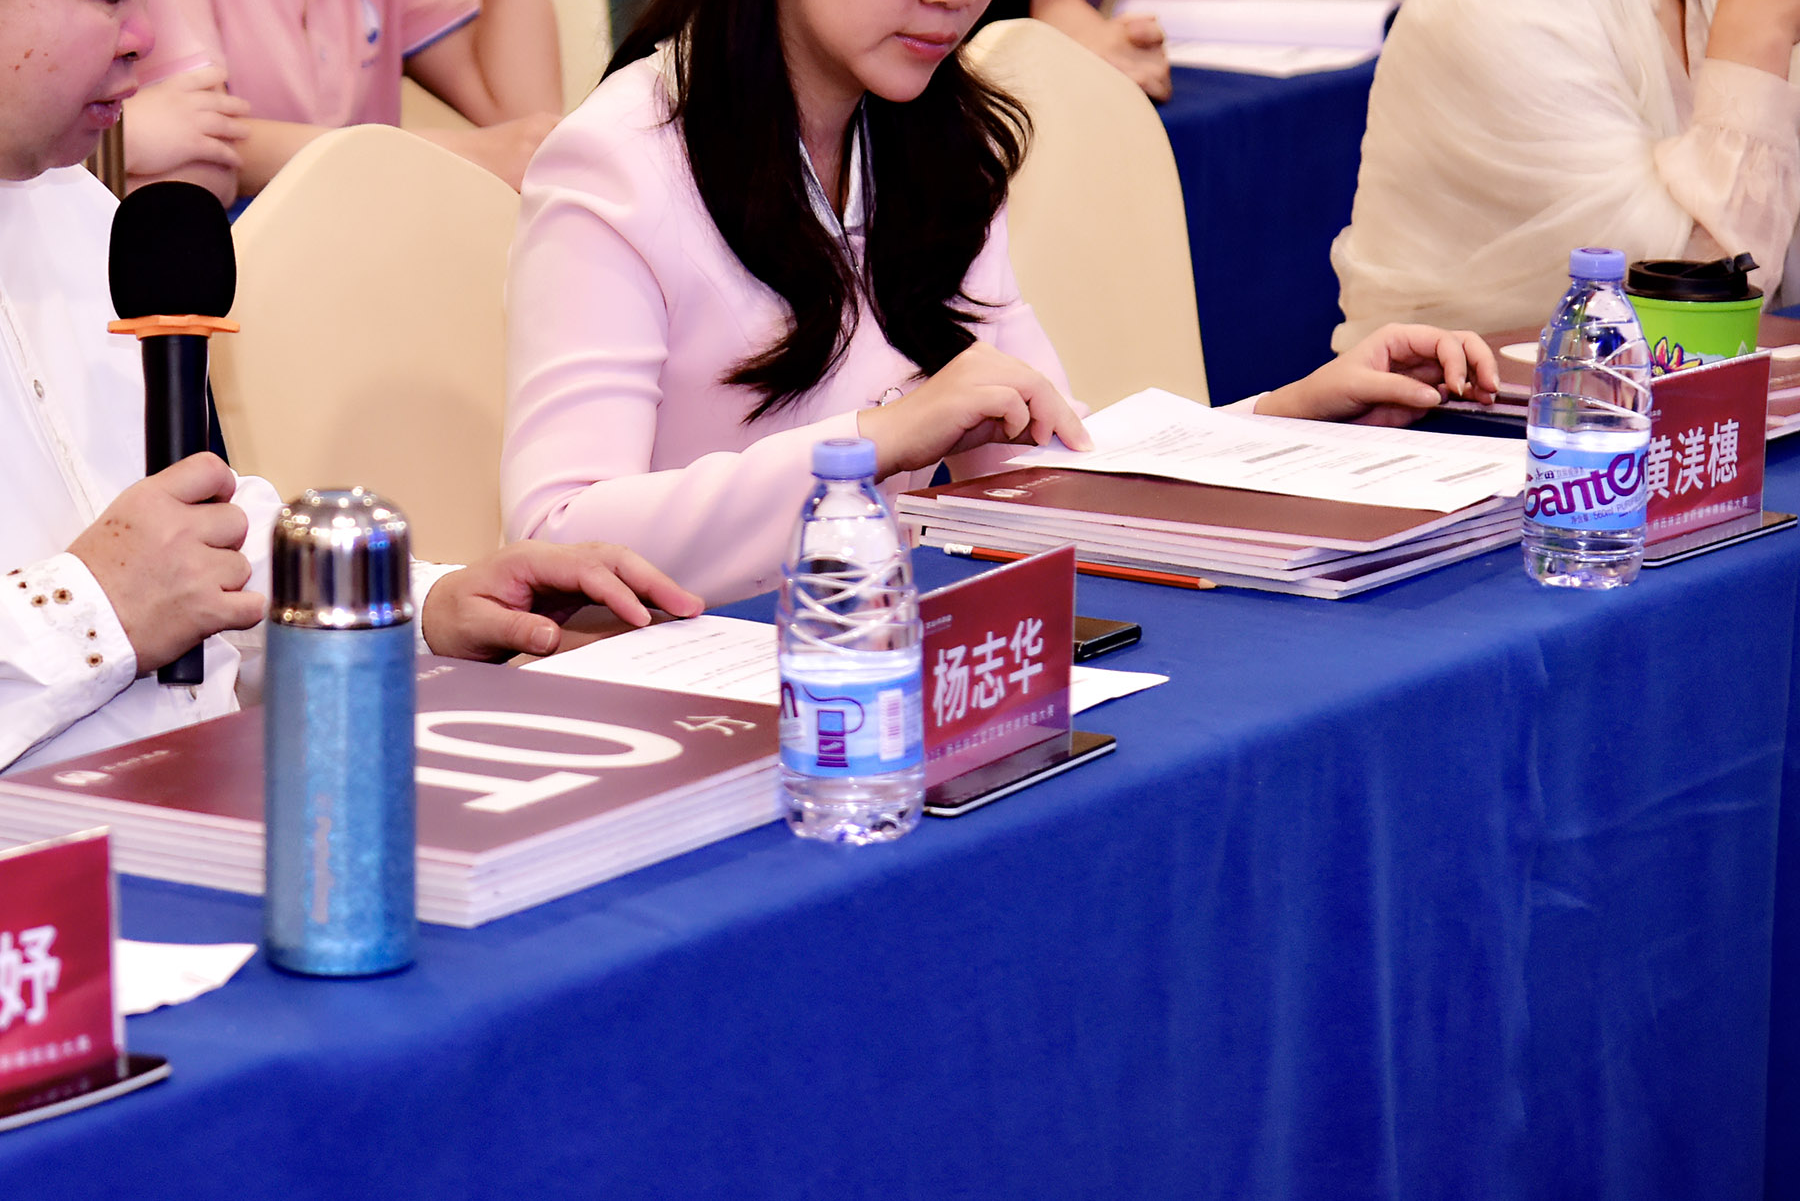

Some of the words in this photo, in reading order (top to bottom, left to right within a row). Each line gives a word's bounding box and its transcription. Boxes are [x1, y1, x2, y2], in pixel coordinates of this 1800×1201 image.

[932, 616, 1044, 729] 杨志华
[414, 709, 683, 815] 10
[672, 712, 757, 737] 分
